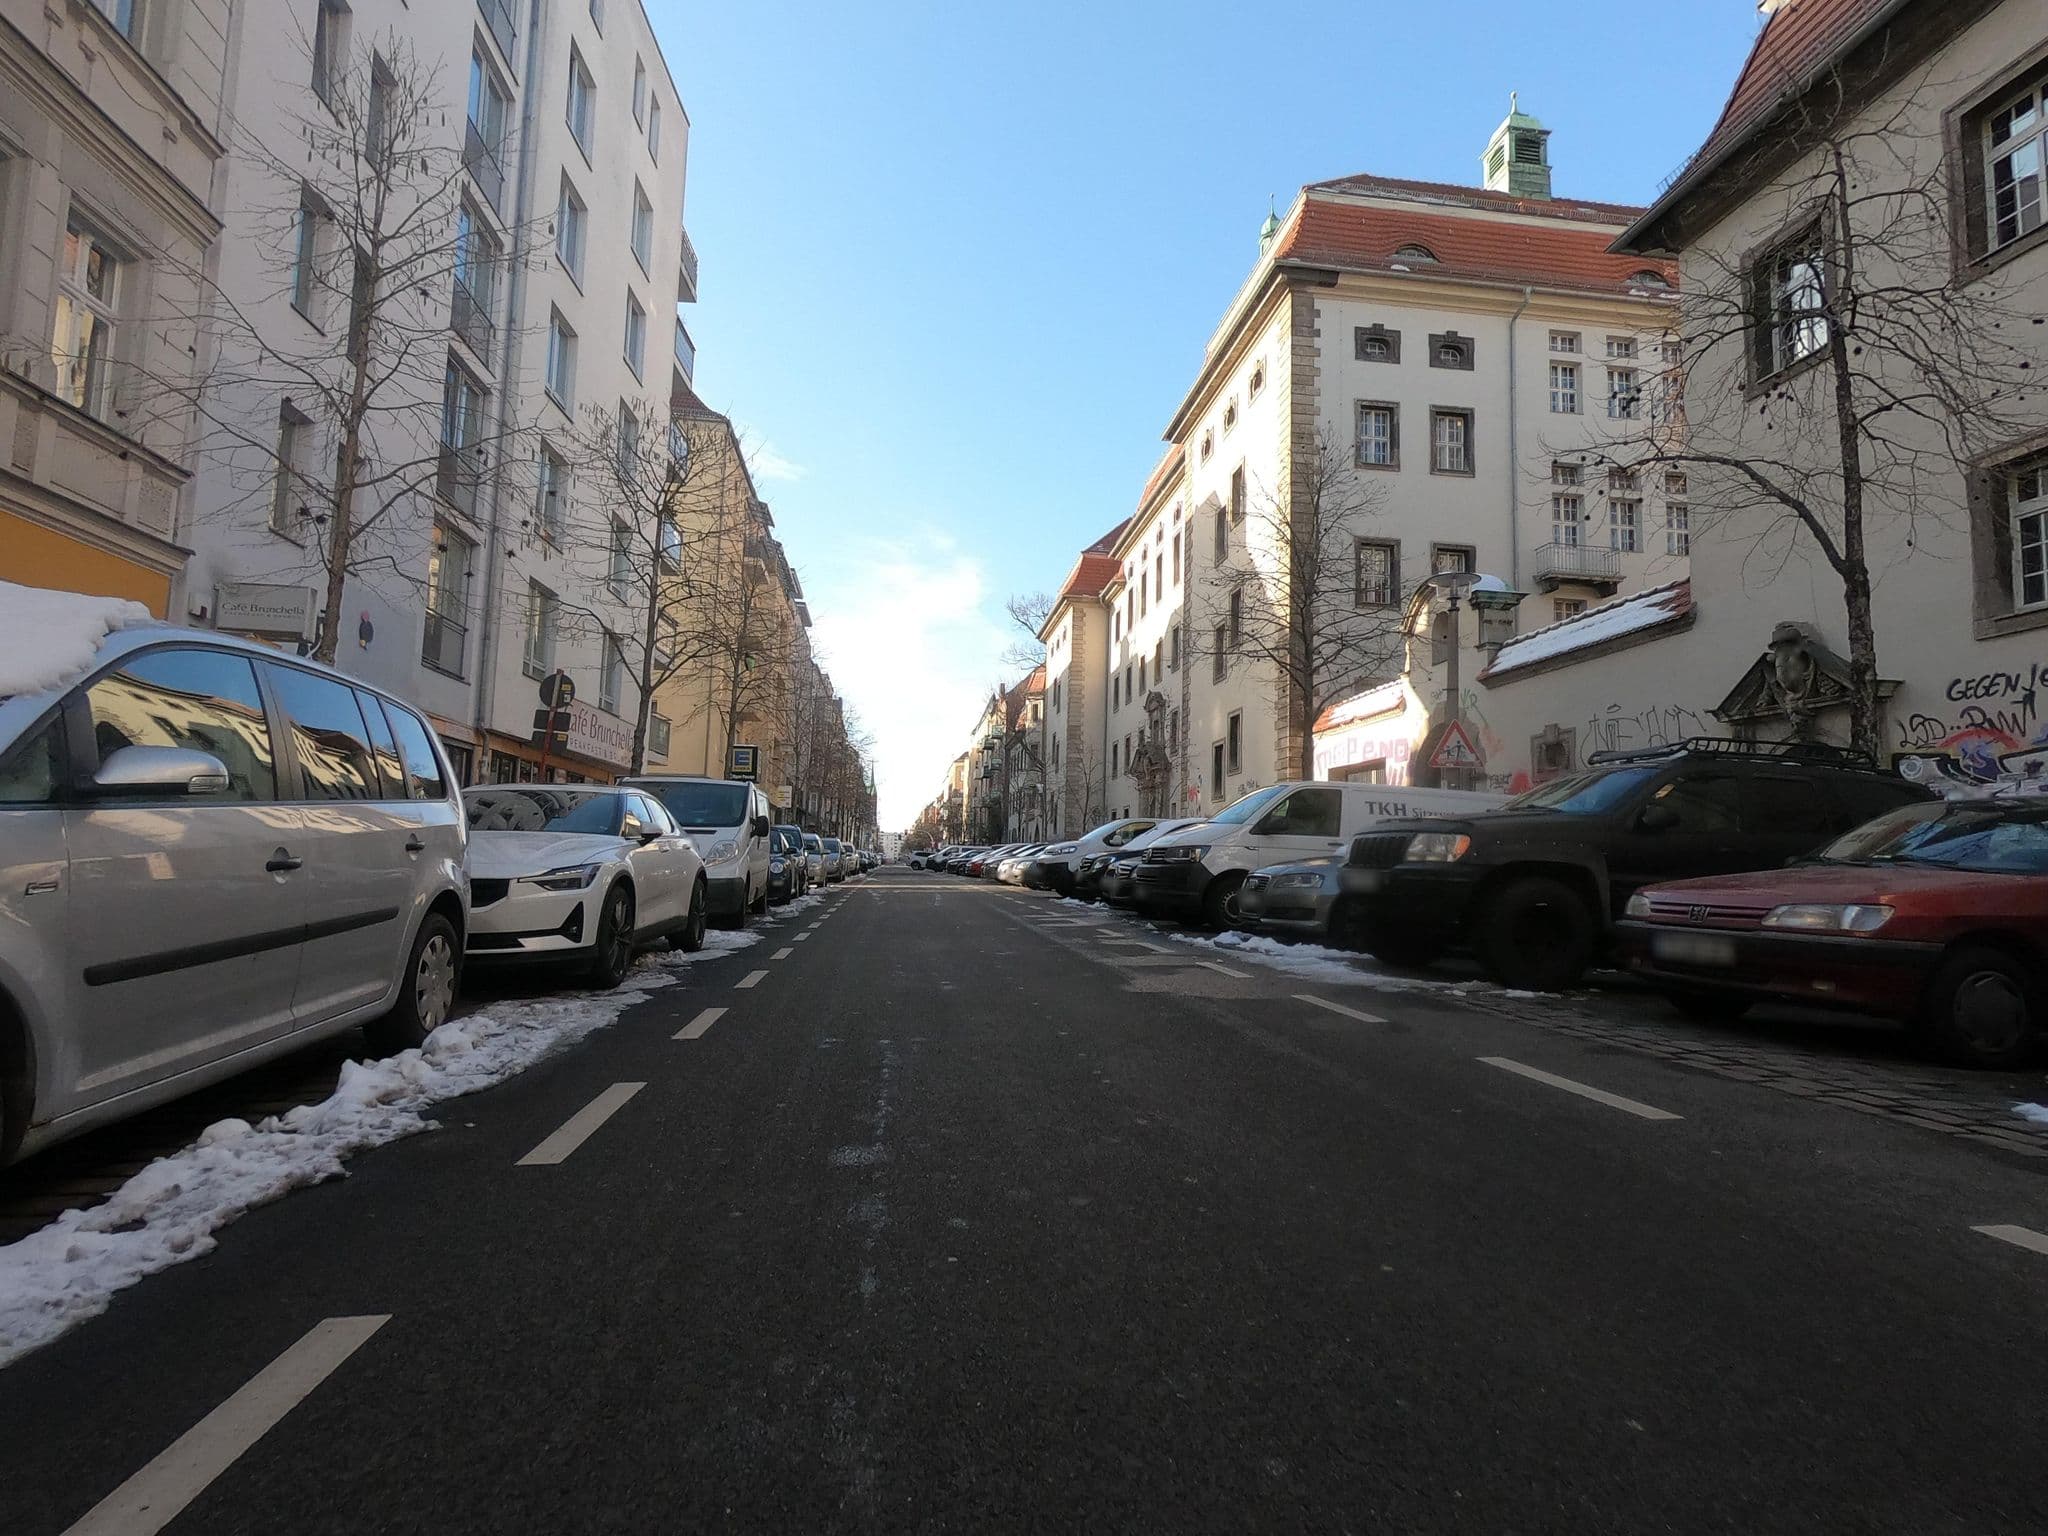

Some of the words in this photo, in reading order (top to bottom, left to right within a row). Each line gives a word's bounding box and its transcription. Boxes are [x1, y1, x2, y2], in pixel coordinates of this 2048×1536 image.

[1946, 673, 2021, 701] GEGEN
[570, 708, 588, 737] afé
[1364, 800, 1407, 817] TKH
